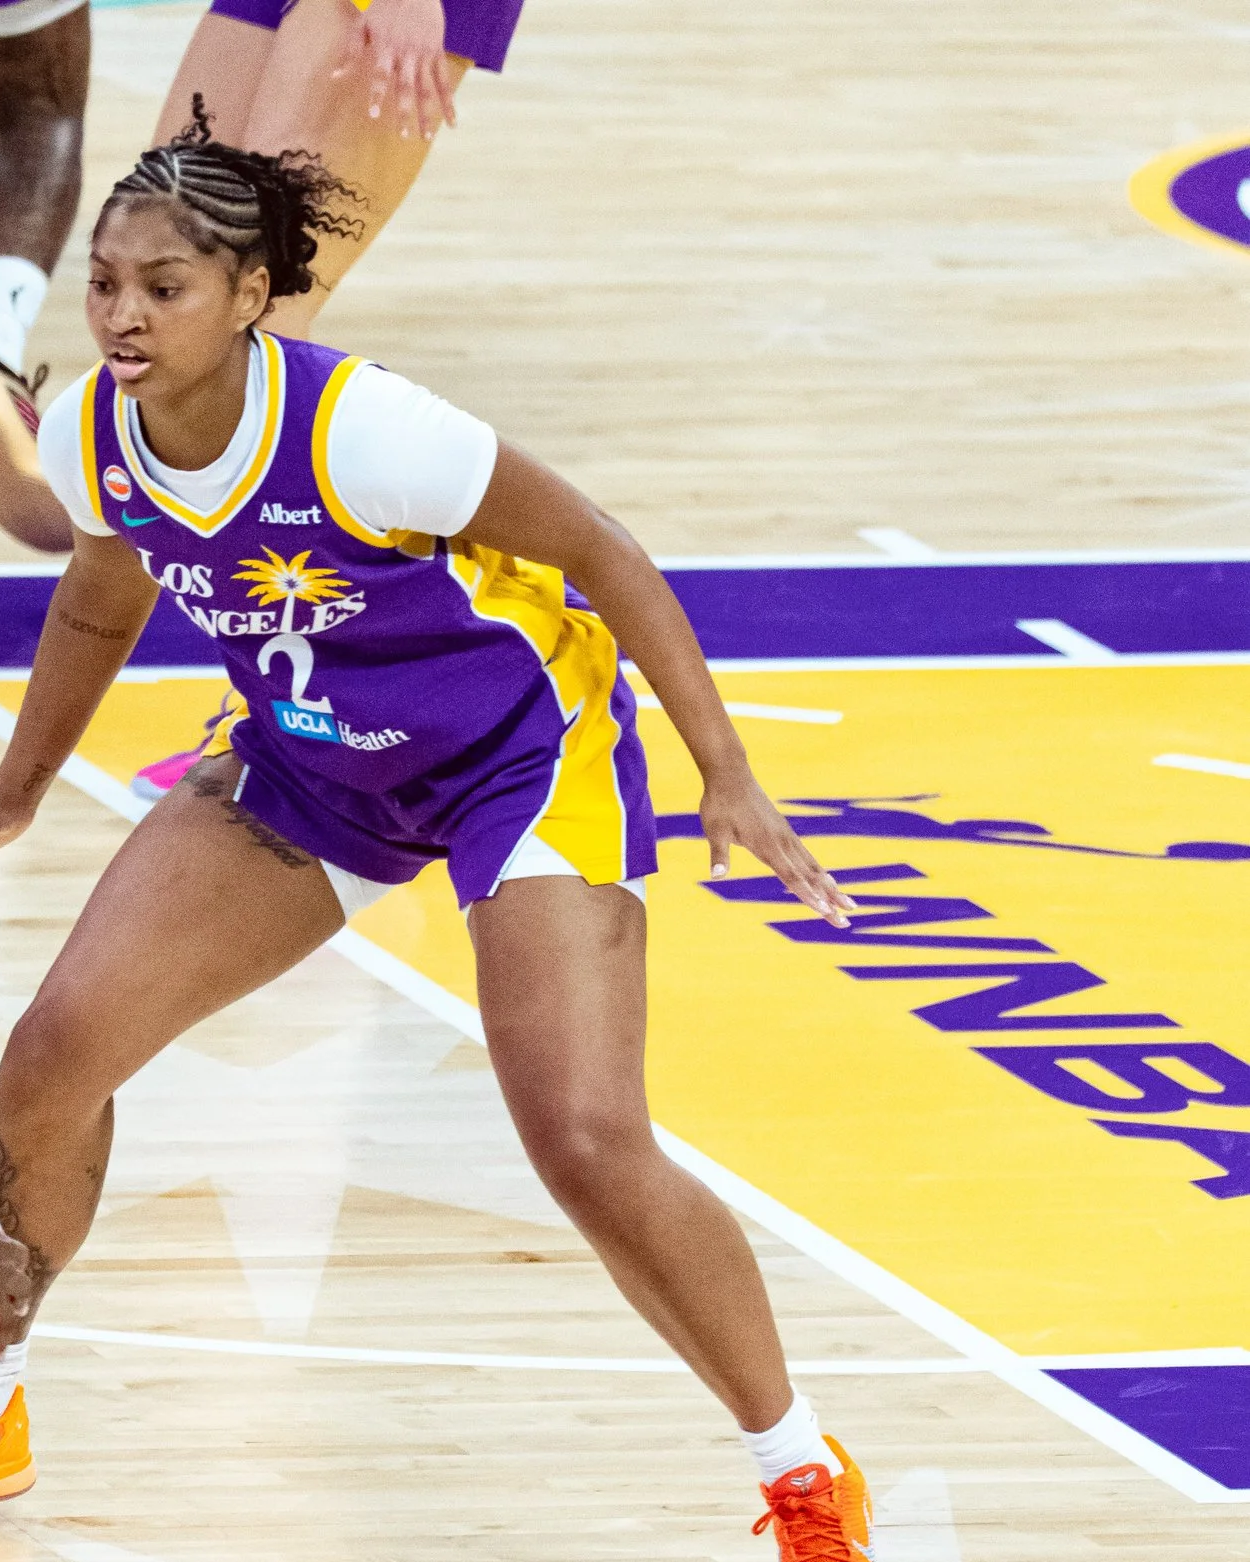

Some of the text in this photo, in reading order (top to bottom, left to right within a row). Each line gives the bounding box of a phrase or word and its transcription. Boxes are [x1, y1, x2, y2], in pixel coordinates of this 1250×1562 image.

[258, 502, 323, 525] Albert
[137, 547, 214, 598] LOS
[256, 633, 334, 714] 2
[282, 710, 411, 751] UCLA Health
